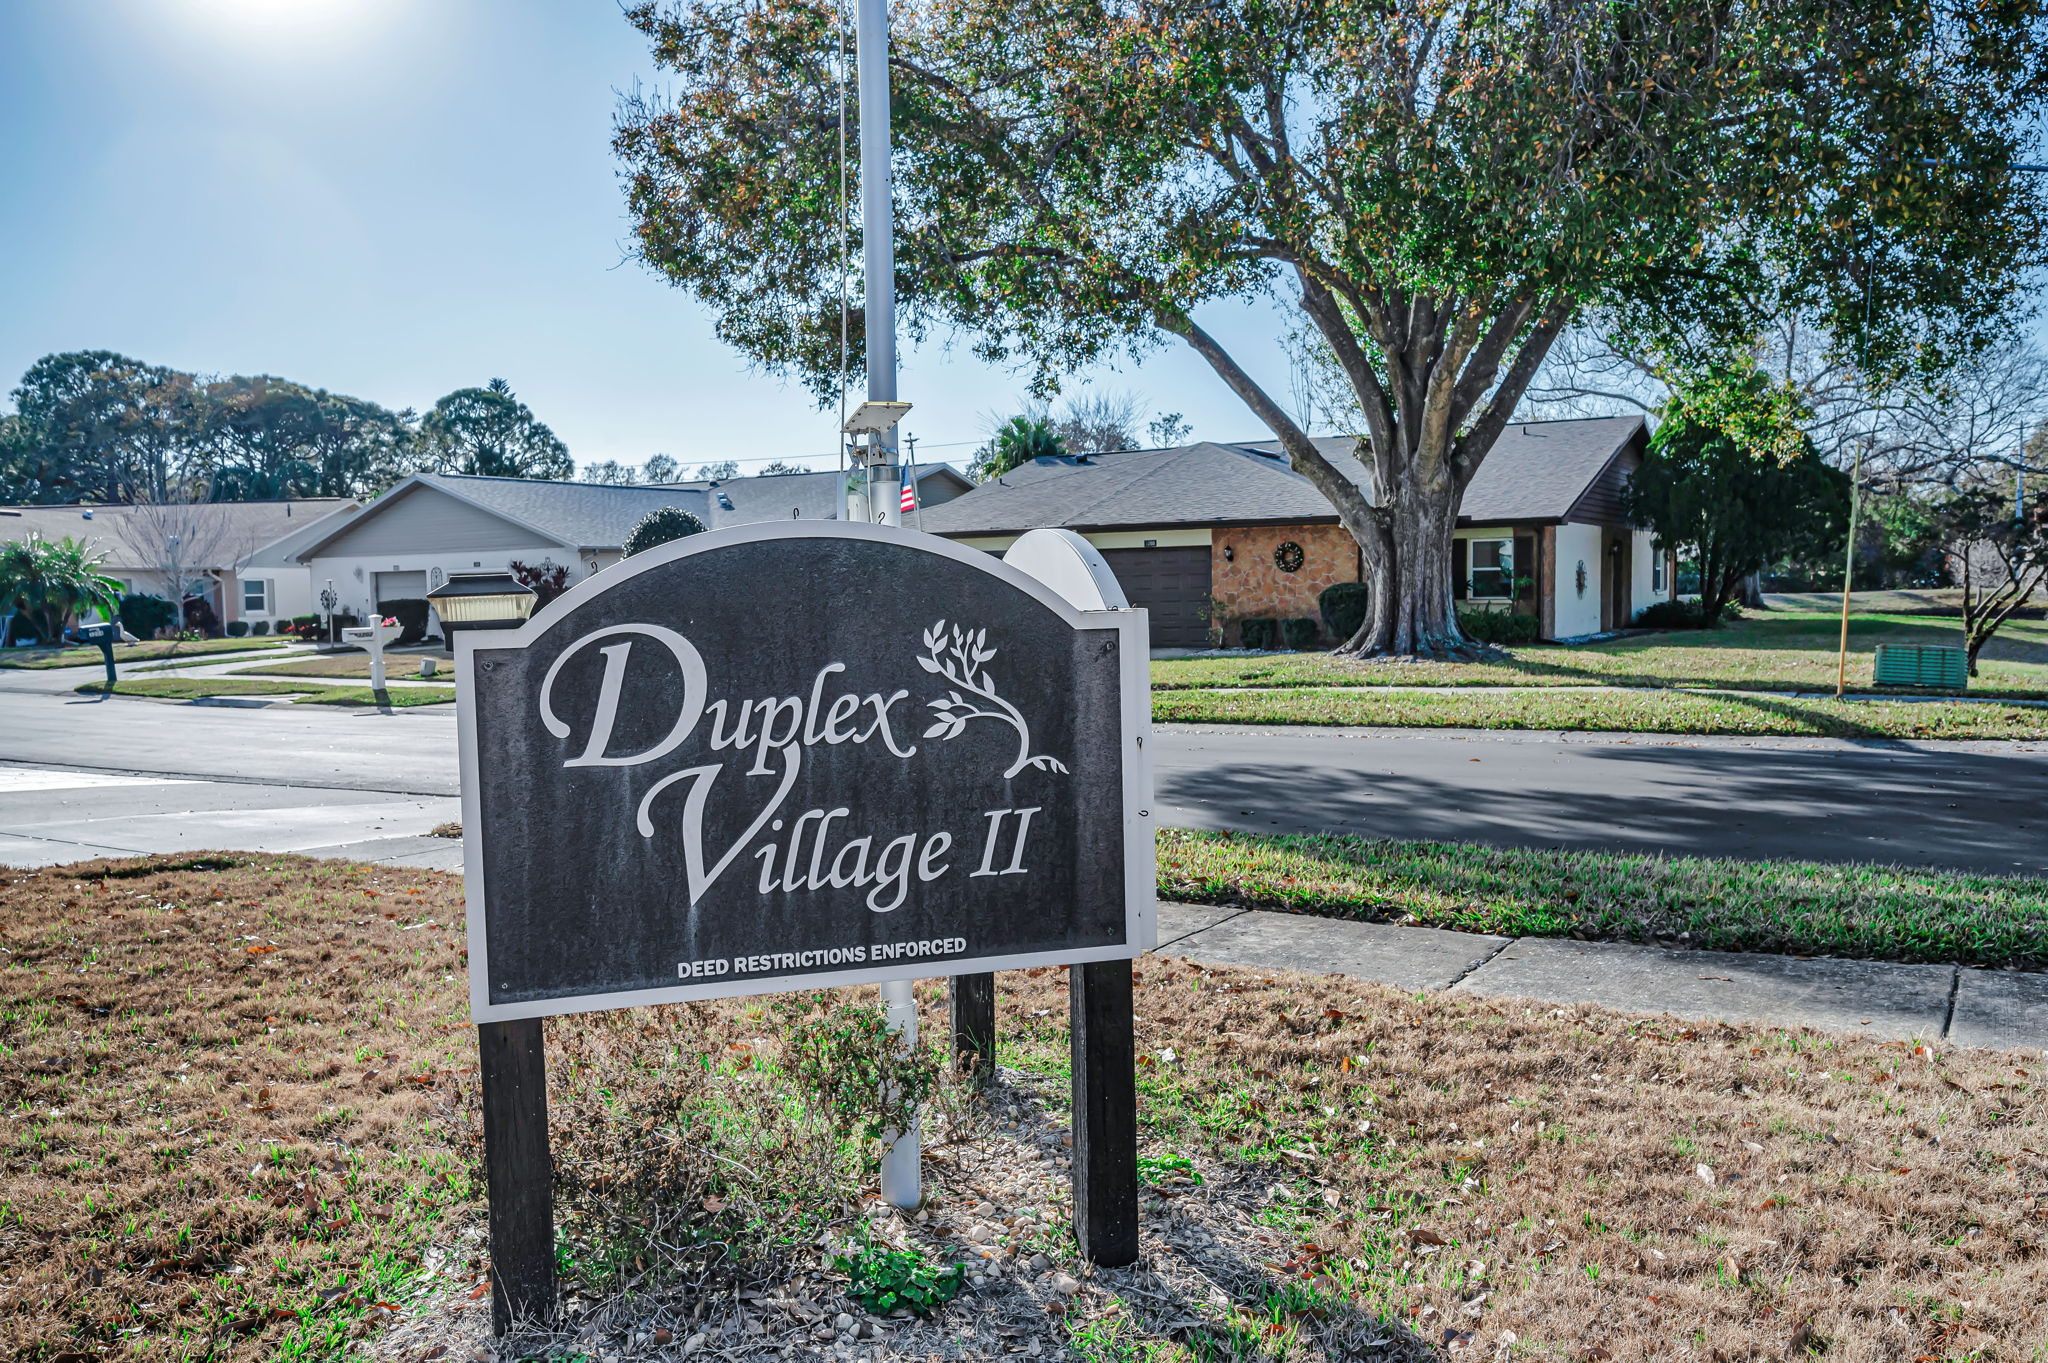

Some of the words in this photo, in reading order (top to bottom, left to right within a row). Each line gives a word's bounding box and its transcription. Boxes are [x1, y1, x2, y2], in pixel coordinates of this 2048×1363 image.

[539, 623, 917, 777] Duplex
[636, 741, 953, 912] Village
[969, 807, 1042, 878] II
[677, 958, 730, 979] DEED
[734, 946, 867, 974] RESTRICTIONS
[870, 937, 967, 961] ENFORCED
